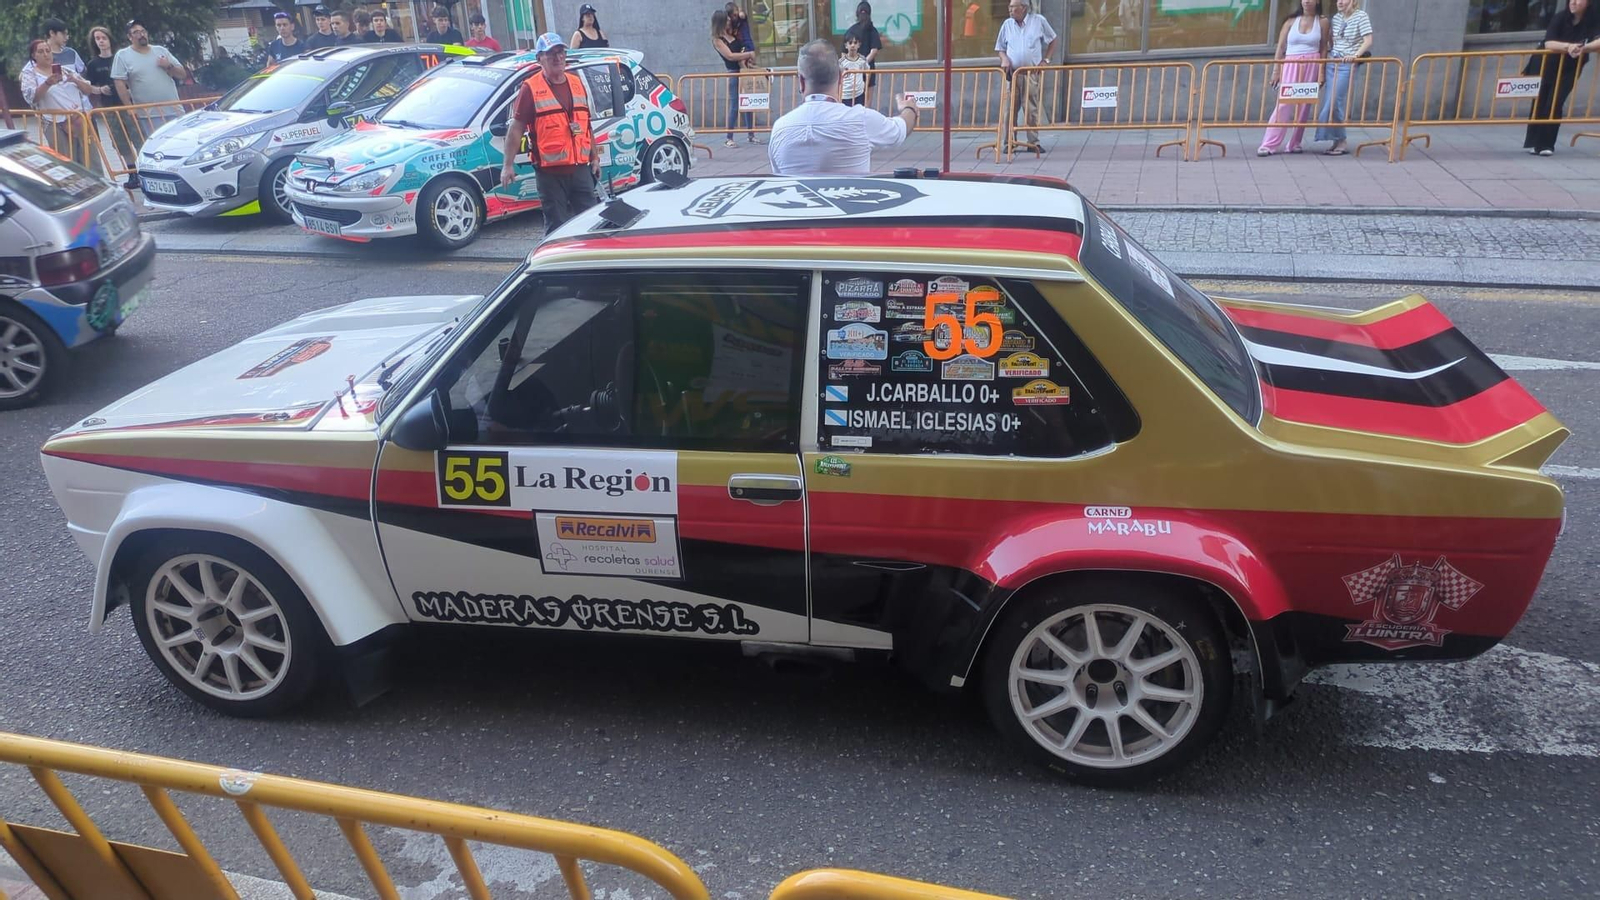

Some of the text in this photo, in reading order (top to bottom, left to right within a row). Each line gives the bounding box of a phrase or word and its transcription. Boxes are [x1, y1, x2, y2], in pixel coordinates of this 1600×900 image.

[838, 283, 880, 293] PIZARRA
[930, 282, 938, 293] 9
[923, 291, 1004, 360] 55
[866, 382, 1000, 404] J.CARBALLO 0+
[848, 409, 1022, 433] ISMAEL IGLESIAS 0+
[444, 456, 505, 501] 55
[515, 464, 556, 489] La
[1086, 506, 1130, 517] CARNES
[576, 520, 636, 537] Recalvi
[1087, 518, 1171, 537] MARABU
[582, 545, 626, 553] HOSPITAL
[584, 552, 676, 567] recoletas salud
[634, 568, 677, 576] OURENSE
[416, 594, 562, 624] MADERAS
[1353, 628, 1436, 643] LUINTRA
